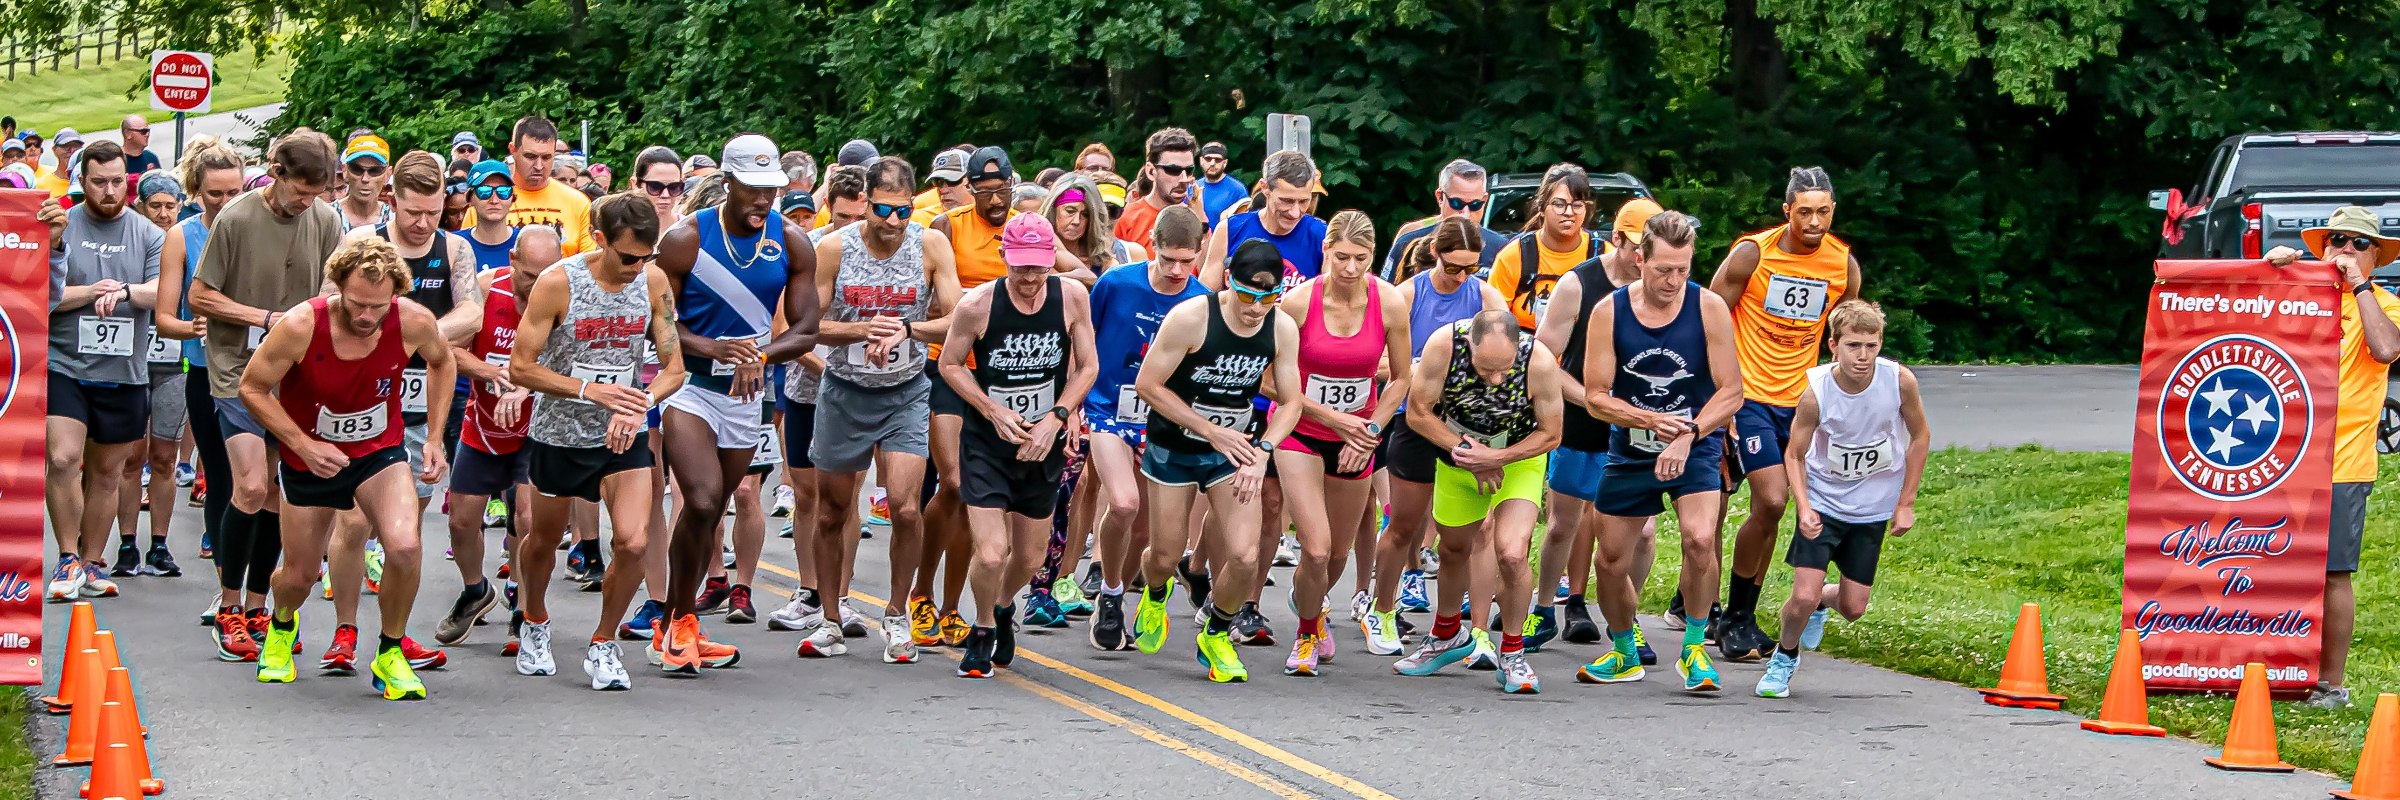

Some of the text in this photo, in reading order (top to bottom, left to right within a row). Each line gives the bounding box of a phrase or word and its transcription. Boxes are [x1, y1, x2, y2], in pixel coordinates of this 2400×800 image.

[161, 62, 203, 75] DO NOT
[164, 88, 198, 100] ENTER
[421, 279, 445, 289] FEET
[1784, 286, 1810, 309] 63
[2158, 292, 2333, 319] There's only one...
[96, 323, 120, 344] 97
[988, 348, 1019, 367] Team
[1627, 347, 1688, 369] BOWLING GREEN
[2173, 344, 2300, 404] GOODLETTSVILLE
[1005, 392, 1039, 414] 191
[1319, 385, 1357, 405] 138
[1665, 394, 1686, 411] CLUB
[331, 415, 374, 434] 183
[1841, 449, 1879, 471] 179
[2178, 450, 2285, 492] TENNESSEE
[2160, 514, 2293, 570] Welcome
[2217, 565, 2254, 597] To
[2134, 600, 2312, 642] Goodlettsville
[2142, 662, 2309, 682] goodingoodlsville
